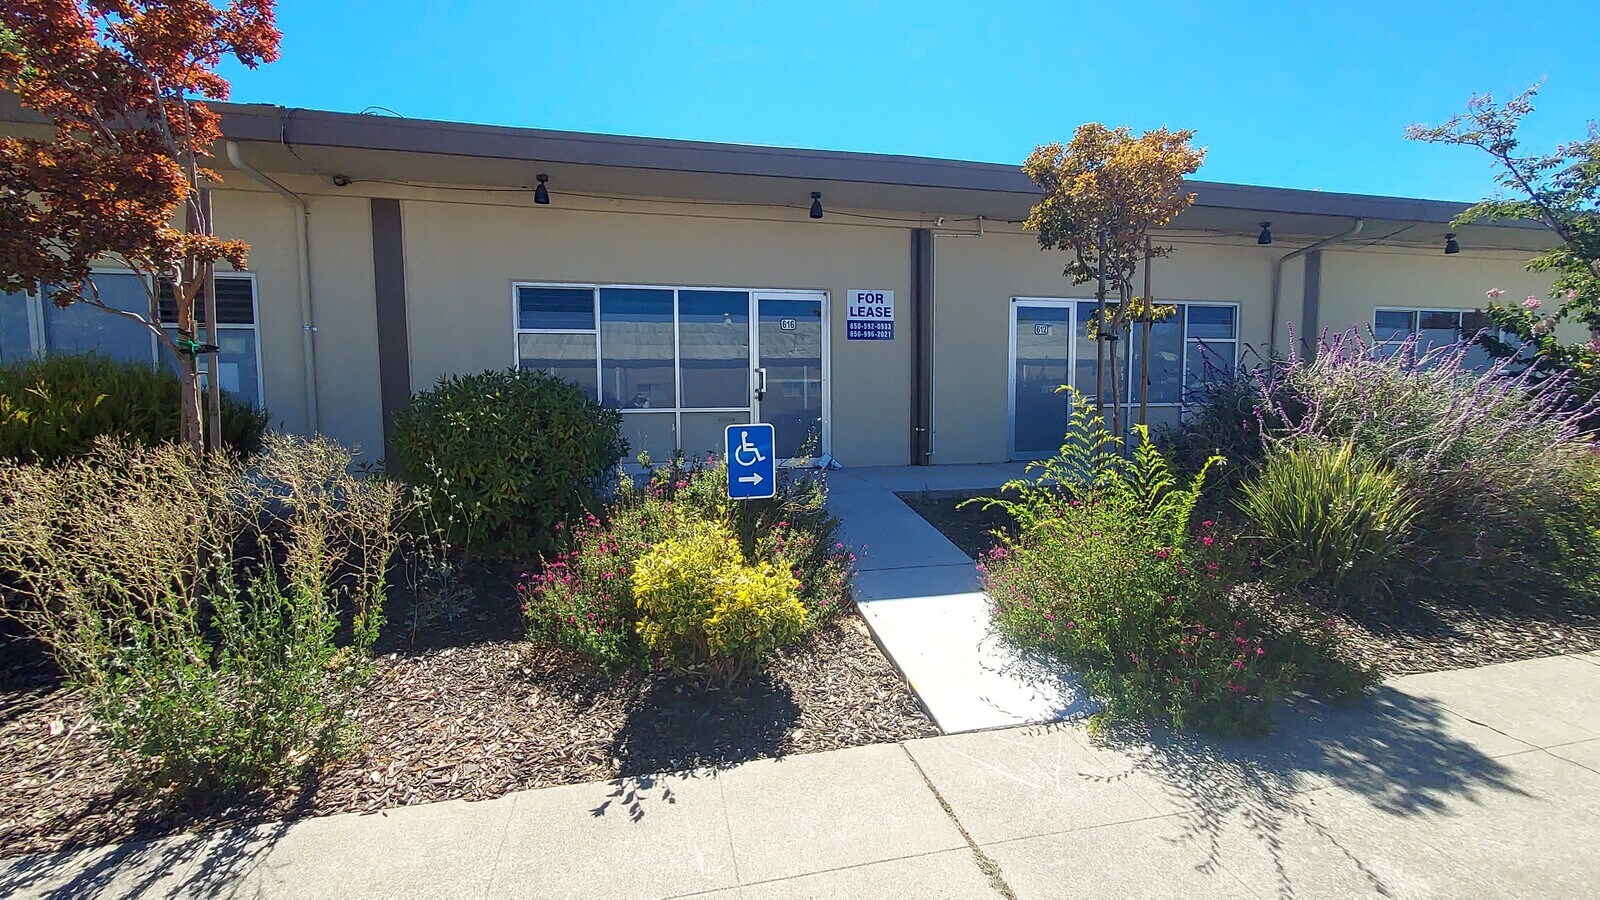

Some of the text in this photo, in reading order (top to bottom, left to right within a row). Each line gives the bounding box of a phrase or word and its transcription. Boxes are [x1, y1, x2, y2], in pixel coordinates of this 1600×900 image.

[857, 293, 884, 304] FOR
[850, 306, 892, 318] LEASE
[782, 320, 795, 329] 616
[849, 322, 892, 330] 650-592-0933
[1036, 325, 1047, 334] 612
